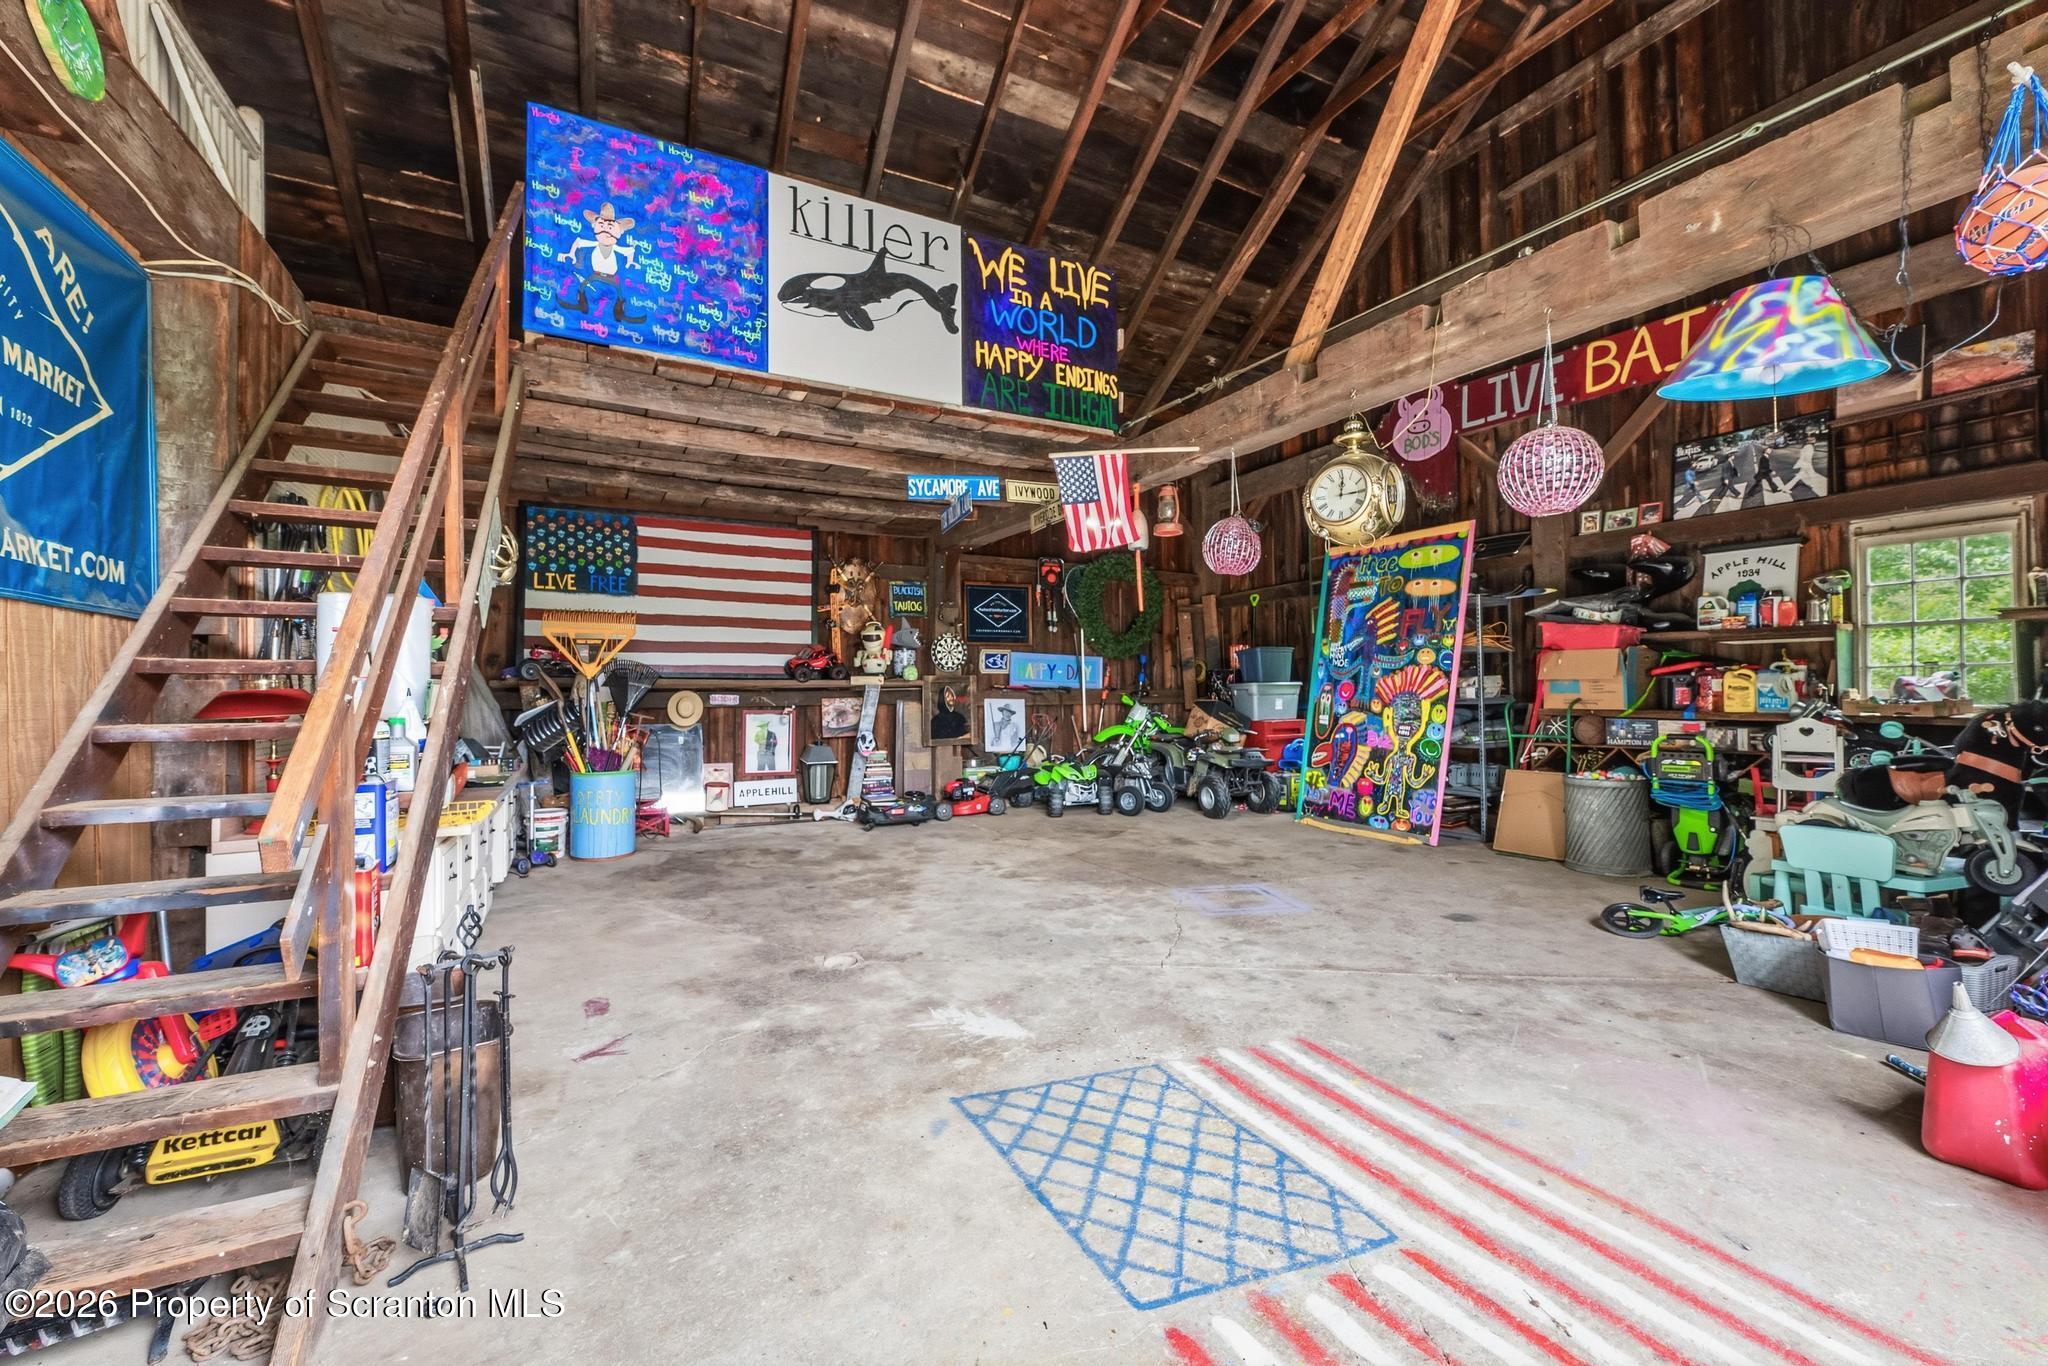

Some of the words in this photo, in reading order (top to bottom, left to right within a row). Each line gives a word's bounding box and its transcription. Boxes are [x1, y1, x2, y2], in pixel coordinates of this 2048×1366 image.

[668, 145, 693, 163] Howdy
[532, 180, 560, 198] Howdy
[554, 213, 582, 233] Howdy
[698, 224, 722, 241] Howdy
[787, 185, 949, 269] killer
[525, 237, 553, 257] Howdy
[626, 235, 652, 254] Howdy
[34, 225, 95, 335] ARE!
[674, 264, 699, 283] Howdy
[967, 237, 1028, 294] WE
[1049, 256, 1113, 310] LIVE
[523, 280, 552, 300] Howdy
[1039, 291, 1054, 311] A
[686, 313, 711, 332] Howdy
[698, 304, 723, 322] Howdy
[990, 298, 1098, 350] WORLD
[1015, 335, 1072, 364] WHERE
[2, 334, 86, 408] MARKET
[975, 339, 1044, 382] HAPPY
[1055, 363, 1119, 400] ENDINGS
[1461, 354, 1565, 430] LIVE
[1585, 303, 1711, 394] BAI
[980, 371, 1033, 414] ARE
[1041, 382, 1120, 432] ILLEGAL
[10, 406, 33, 428] 1822
[908, 478, 970, 498] SYCAMORE
[977, 479, 1000, 498] AVE
[1014, 486, 1055, 499] IVYWOOD
[1711, 557, 1750, 580] APPLE
[1756, 556, 1787, 571] HILL
[1737, 568, 1761, 578] 1934
[533, 571, 577, 591] LIVE
[589, 574, 628, 594] FREE
[893, 600, 923, 612] TAUTOG
[1401, 602, 1453, 638] FLY
[739, 786, 794, 798] APPLEHILL
[1328, 788, 1356, 820] ME
[572, 807, 635, 826] LAUNDRY
[163, 1124, 267, 1155] Kettcar
